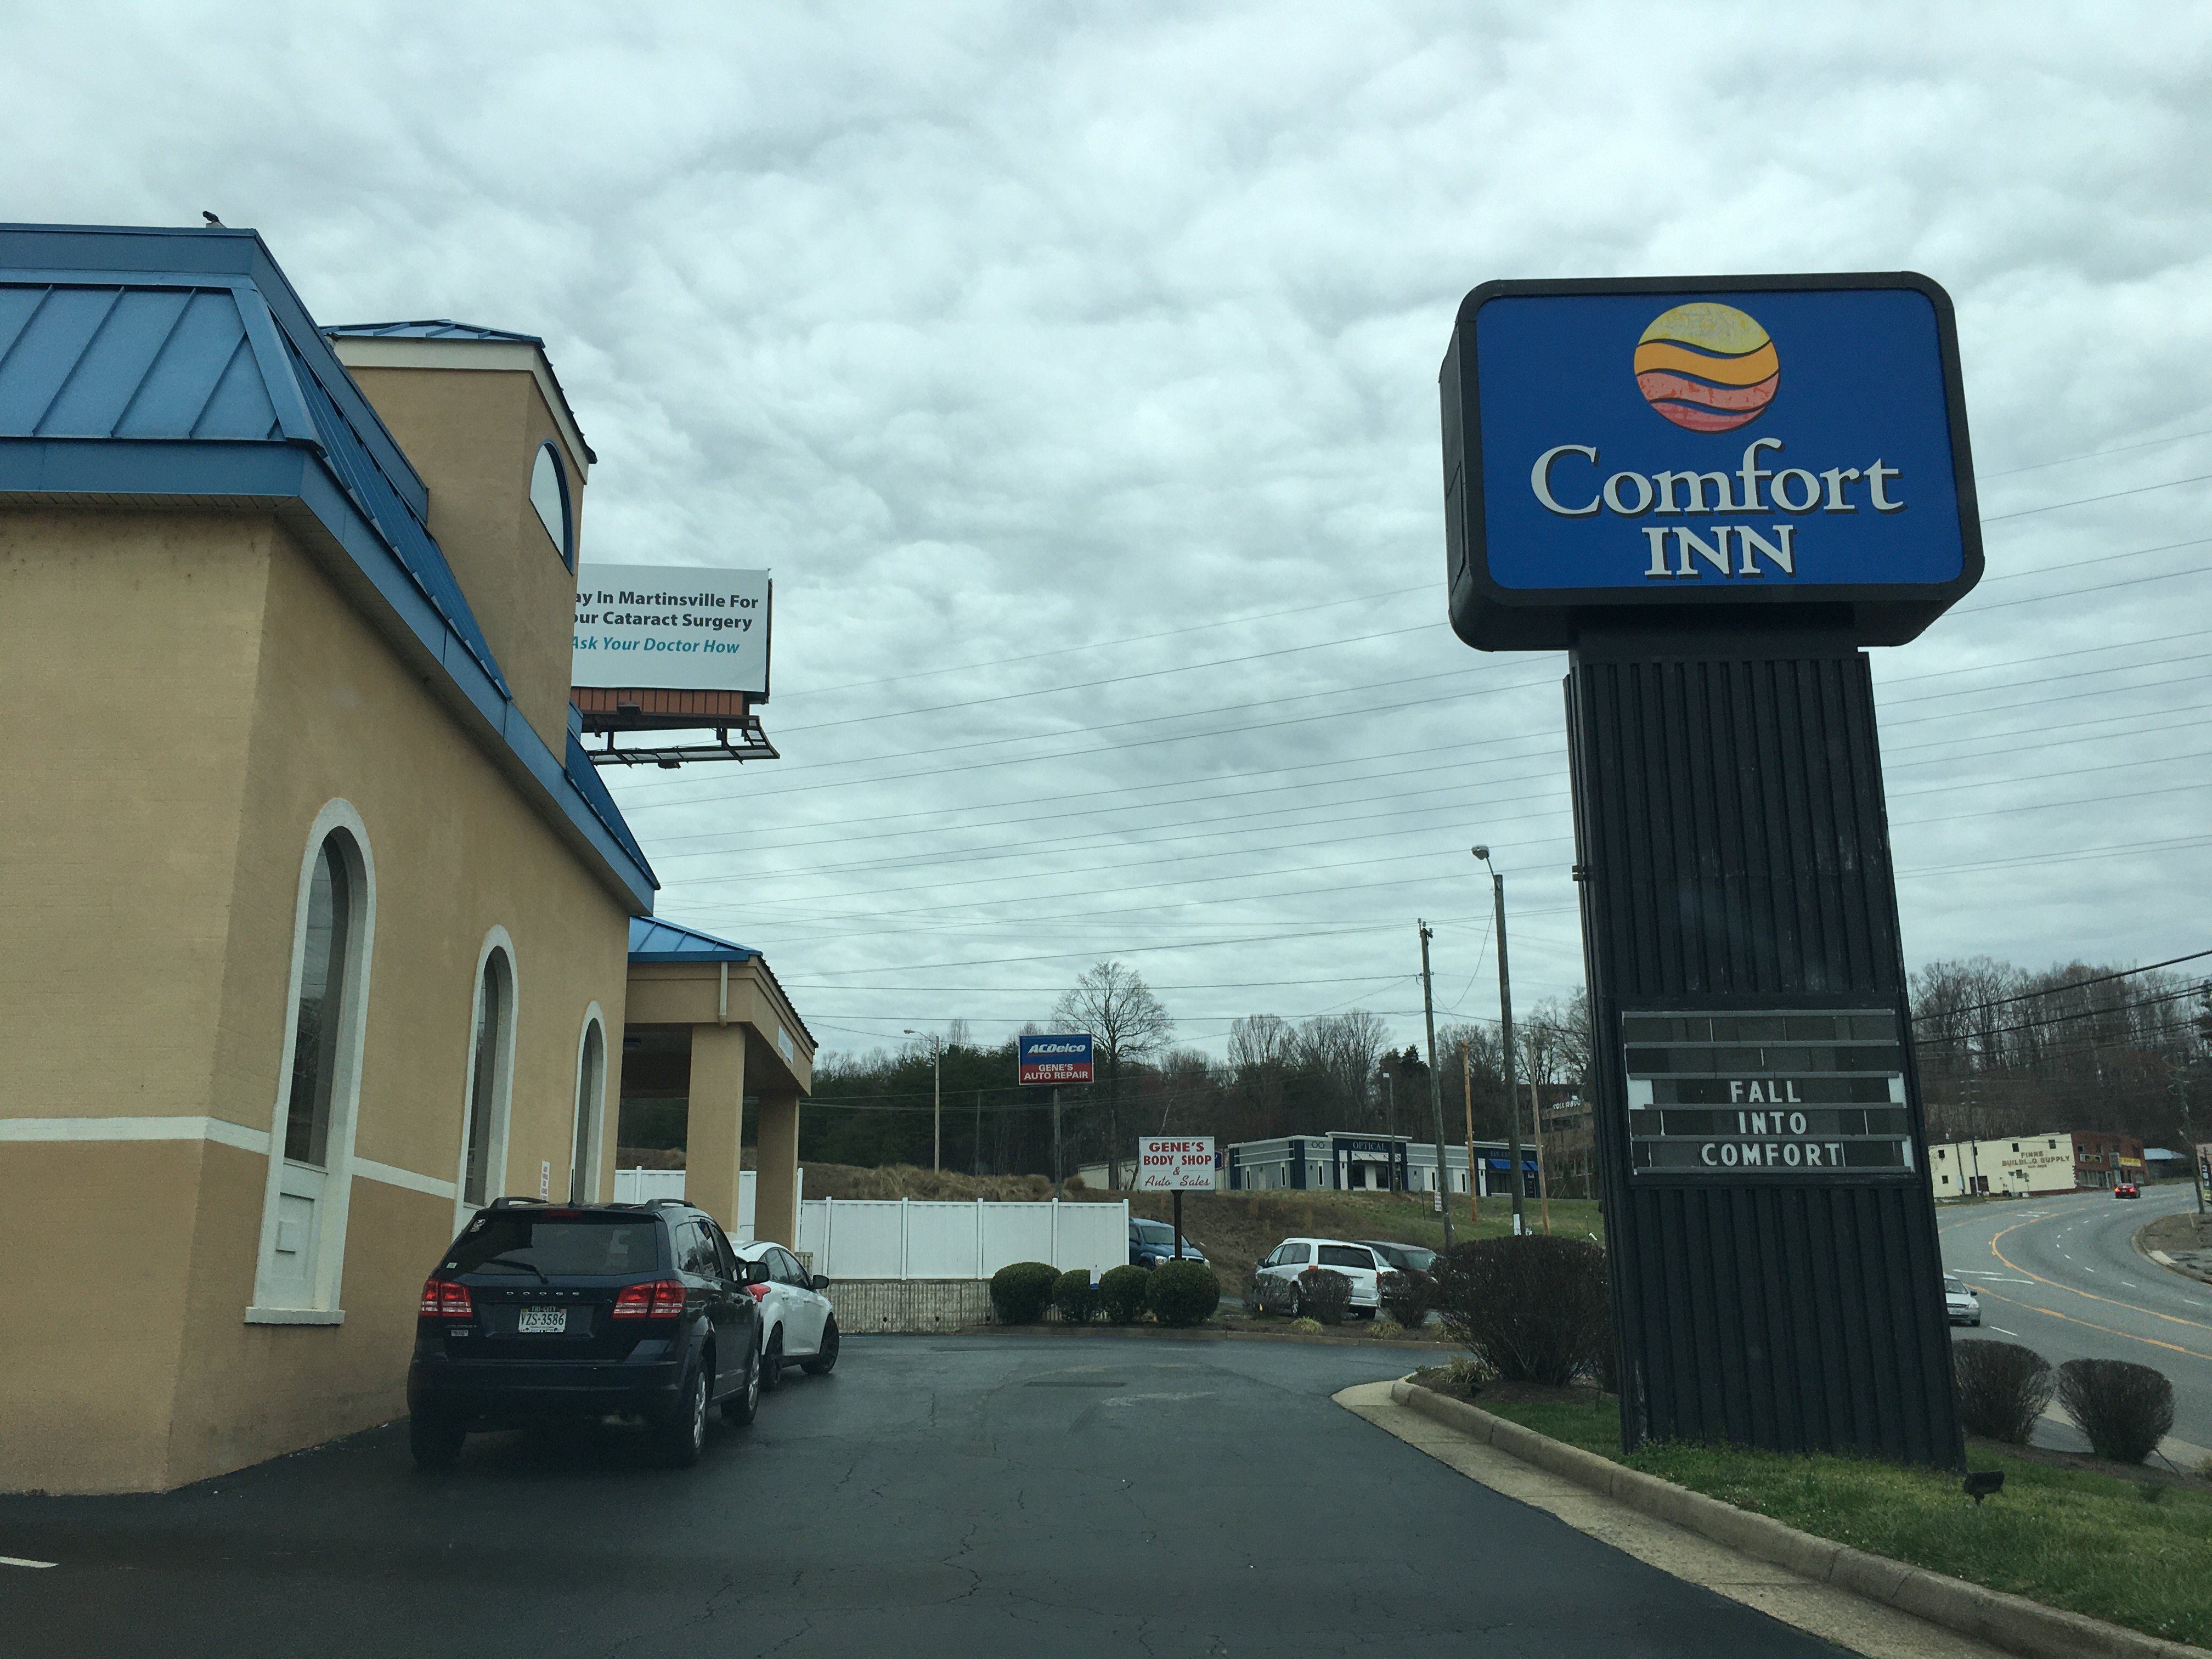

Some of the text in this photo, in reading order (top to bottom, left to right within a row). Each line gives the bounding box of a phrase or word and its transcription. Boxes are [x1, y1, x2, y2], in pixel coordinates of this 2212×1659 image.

[1531, 437, 1909, 515] Comfort
[1642, 524, 1797, 580] INN
[597, 591, 613, 603] In
[618, 591, 725, 607] Martinsville
[730, 595, 759, 608] For
[603, 611, 678, 627] Cataract
[682, 613, 753, 632] Surgery
[572, 636, 740, 654] Ask Your Doctor How
[1028, 1043, 1086, 1053] ACDelco
[1039, 1063, 1074, 1071] GENE'S
[1024, 1071, 1088, 1080] AUTO REPAIR
[1730, 1081, 1801, 1103] FALL
[1738, 1112, 1807, 1135] INTO
[1149, 1142, 1205, 1152] GENE'S
[1352, 1141, 1386, 1151] OPTICAL
[1143, 1155, 1212, 1165] BODY SHOP
[1701, 1143, 1839, 1166] COMFORT
[1172, 1166, 1180, 1175] &
[1144, 1175, 1211, 1186] Auto Sales
